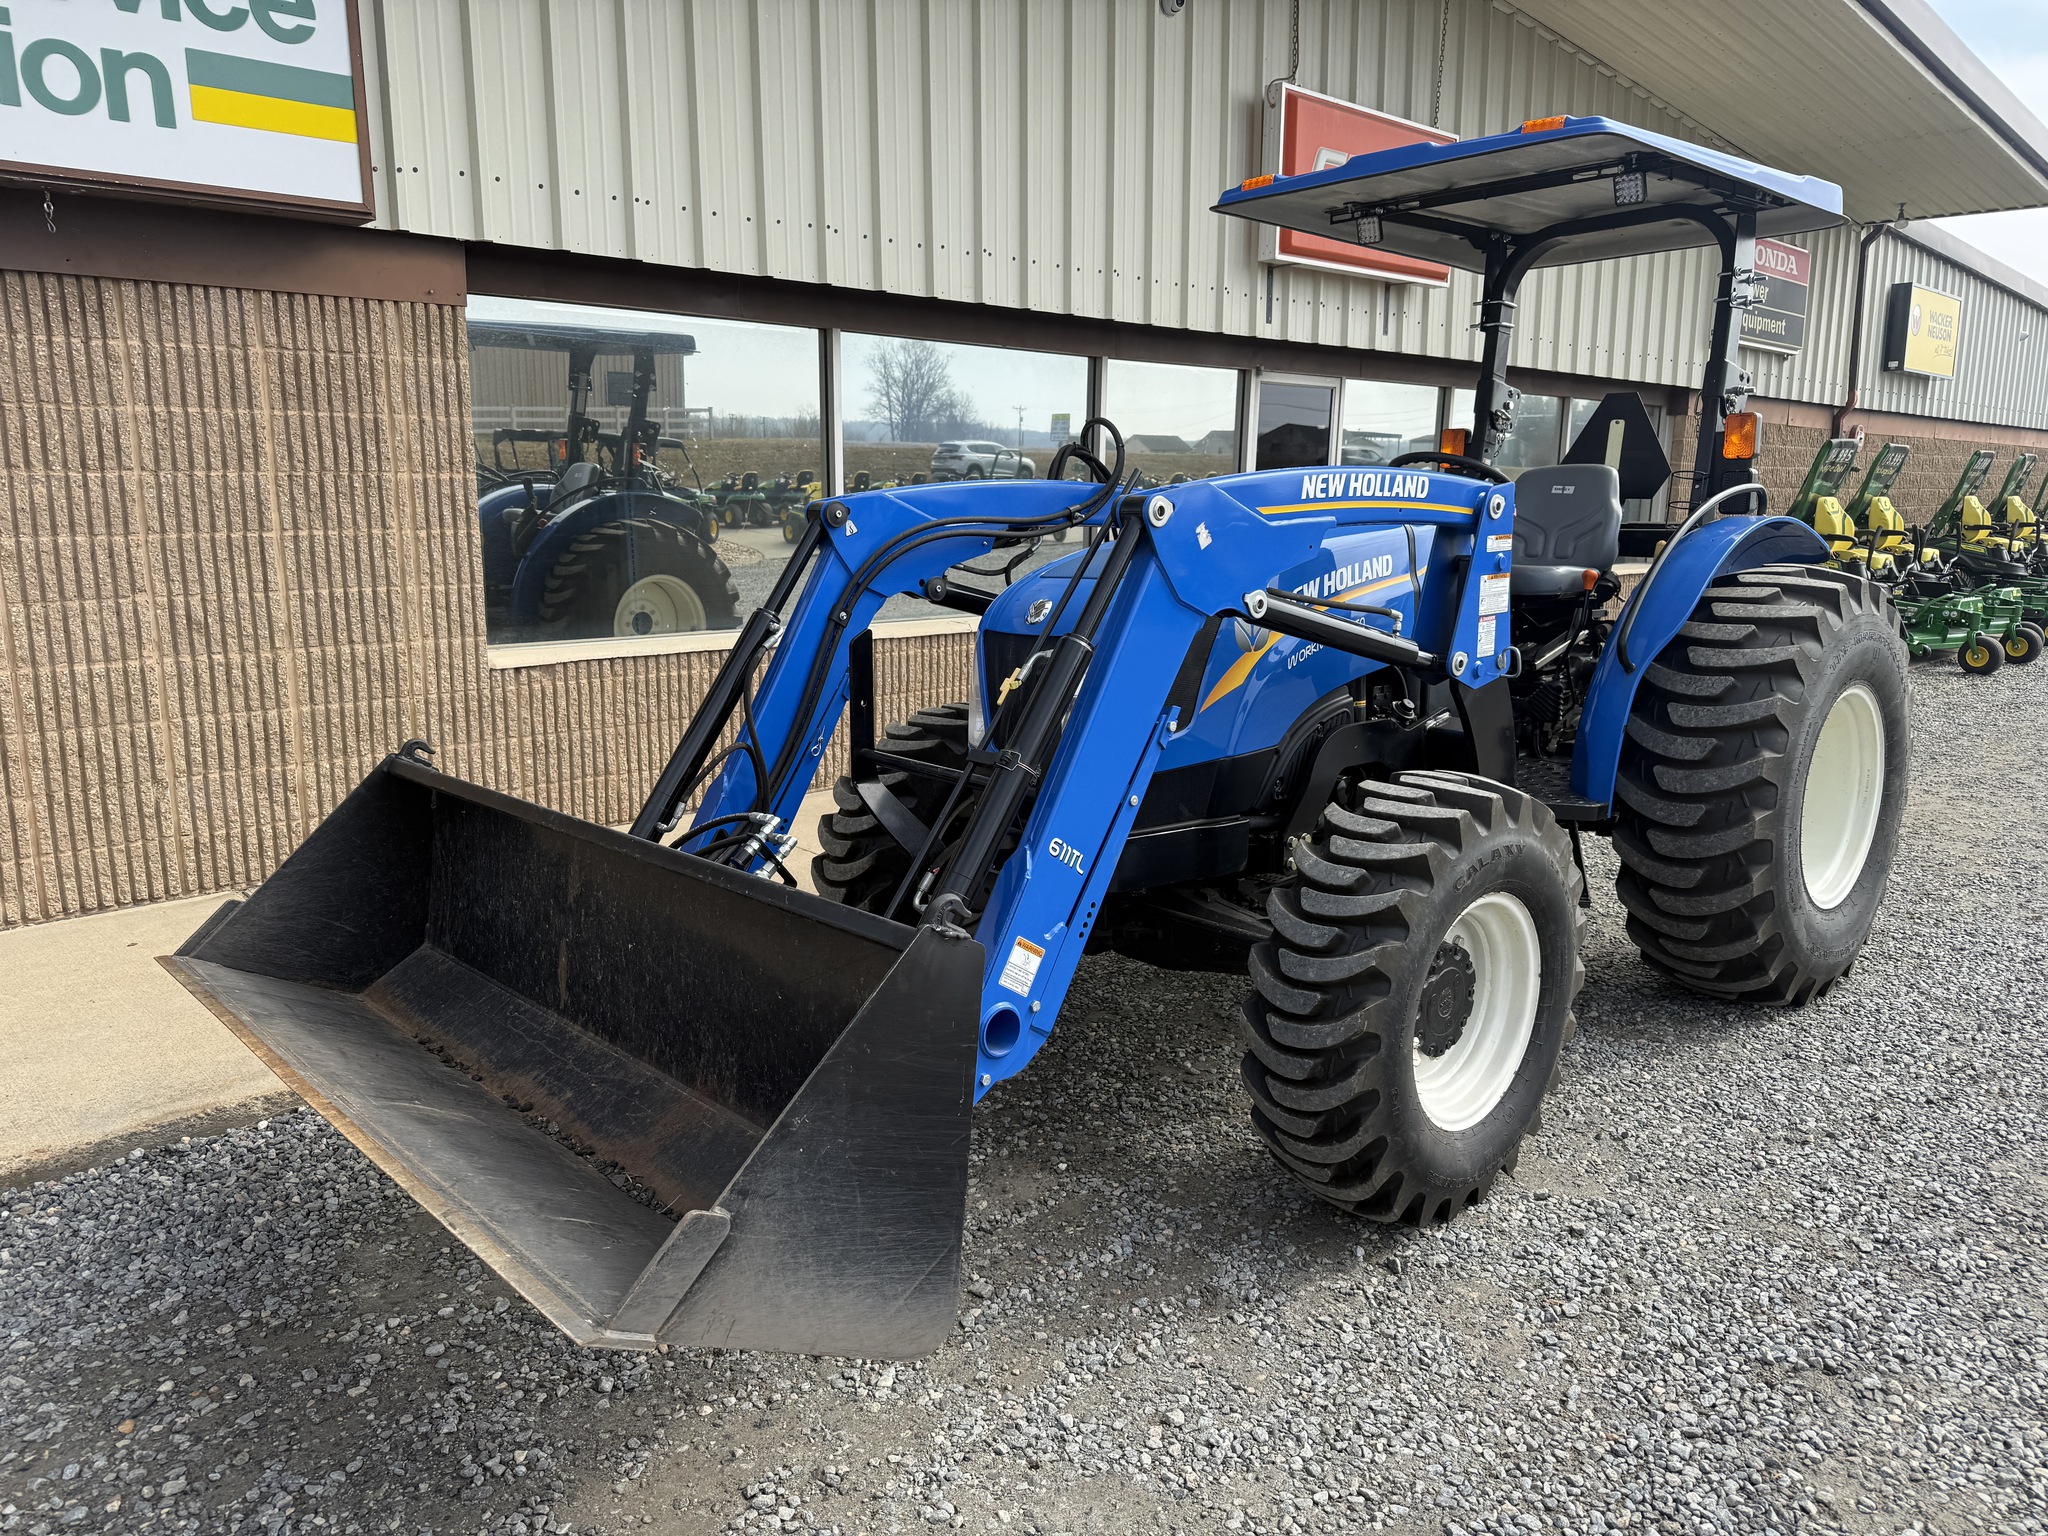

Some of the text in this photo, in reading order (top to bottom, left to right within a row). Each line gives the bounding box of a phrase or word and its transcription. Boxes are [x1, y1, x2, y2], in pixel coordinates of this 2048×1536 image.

[1755, 244, 1798, 275] ONDA
[1753, 283, 1769, 300] wer
[1742, 310, 1787, 336] quipment
[1929, 310, 1953, 329] WACKER
[1927, 324, 1953, 343] NEUSON
[1301, 473, 1430, 500] NEW HOLLAND
[1323, 554, 1393, 598] HOLLAND
[1048, 837, 1084, 875] 611TL
[1452, 843, 1526, 894] GALAXY
